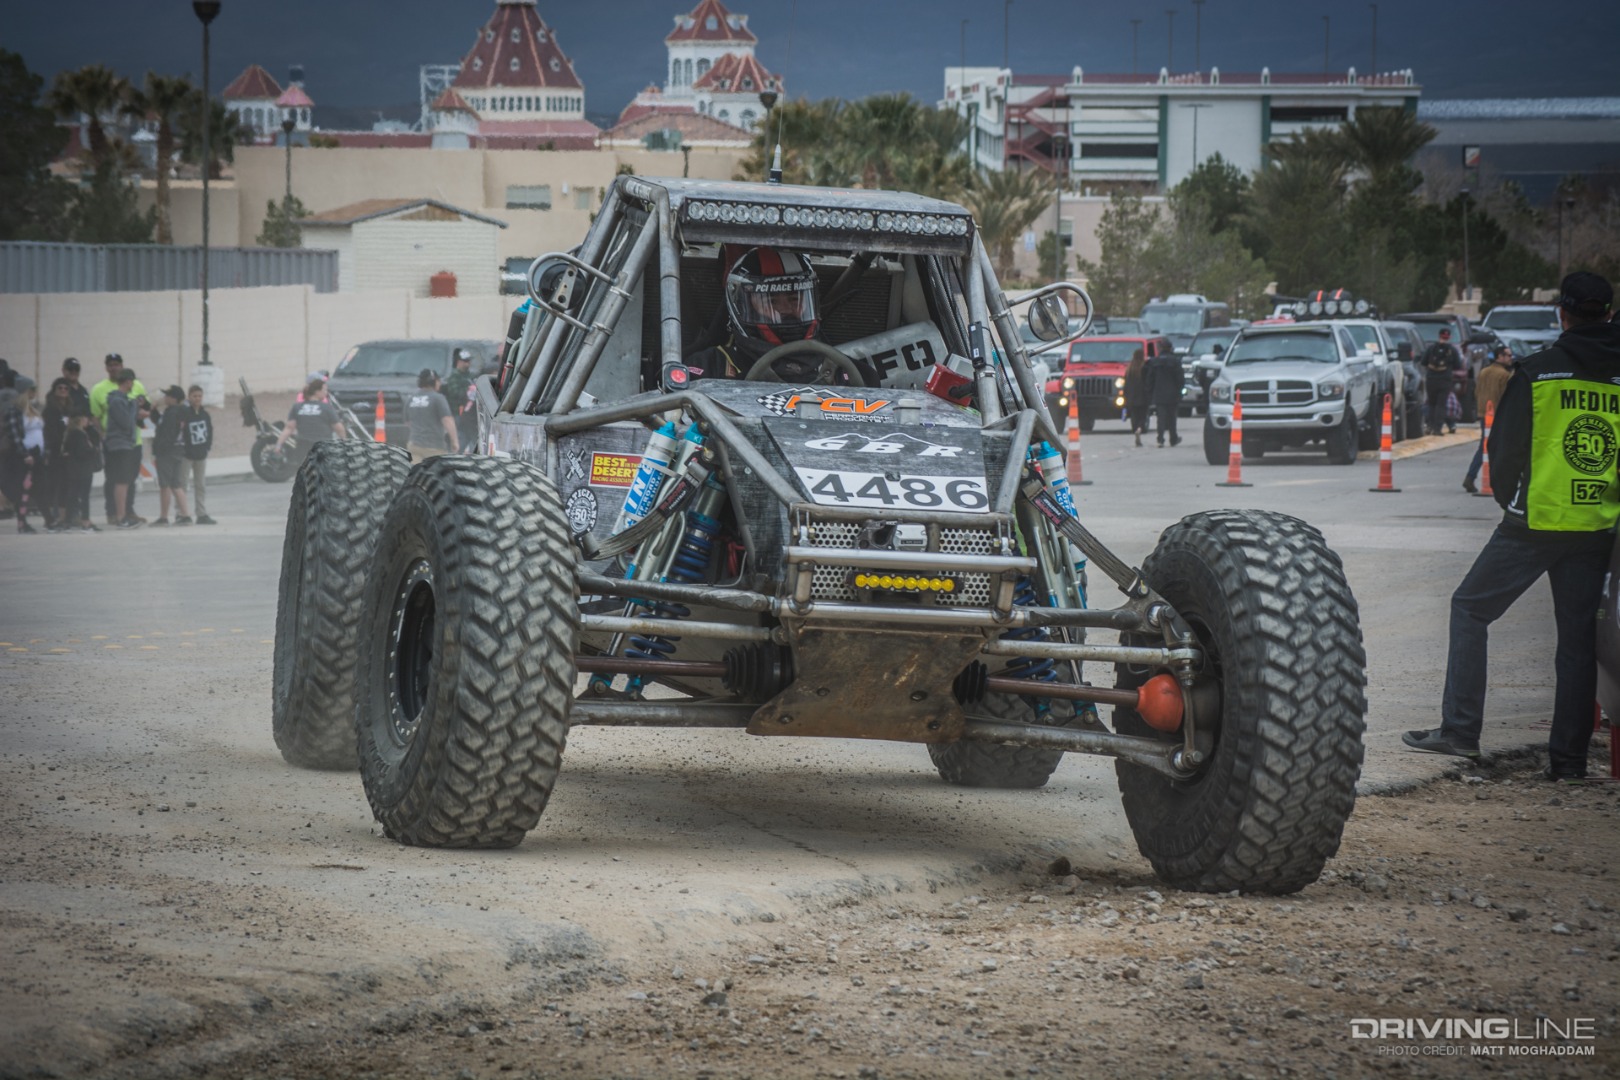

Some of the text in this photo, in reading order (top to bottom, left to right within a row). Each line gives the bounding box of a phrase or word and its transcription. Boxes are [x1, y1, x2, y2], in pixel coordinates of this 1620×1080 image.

[756, 284, 769, 292] PCI
[1561, 389, 1619, 414] MEDIA
[1577, 433, 1605, 456] 50
[594, 456, 627, 467] BEST
[593, 465, 637, 477] DESERT
[811, 473, 989, 510] 4486
[575, 508, 587, 521] 50
